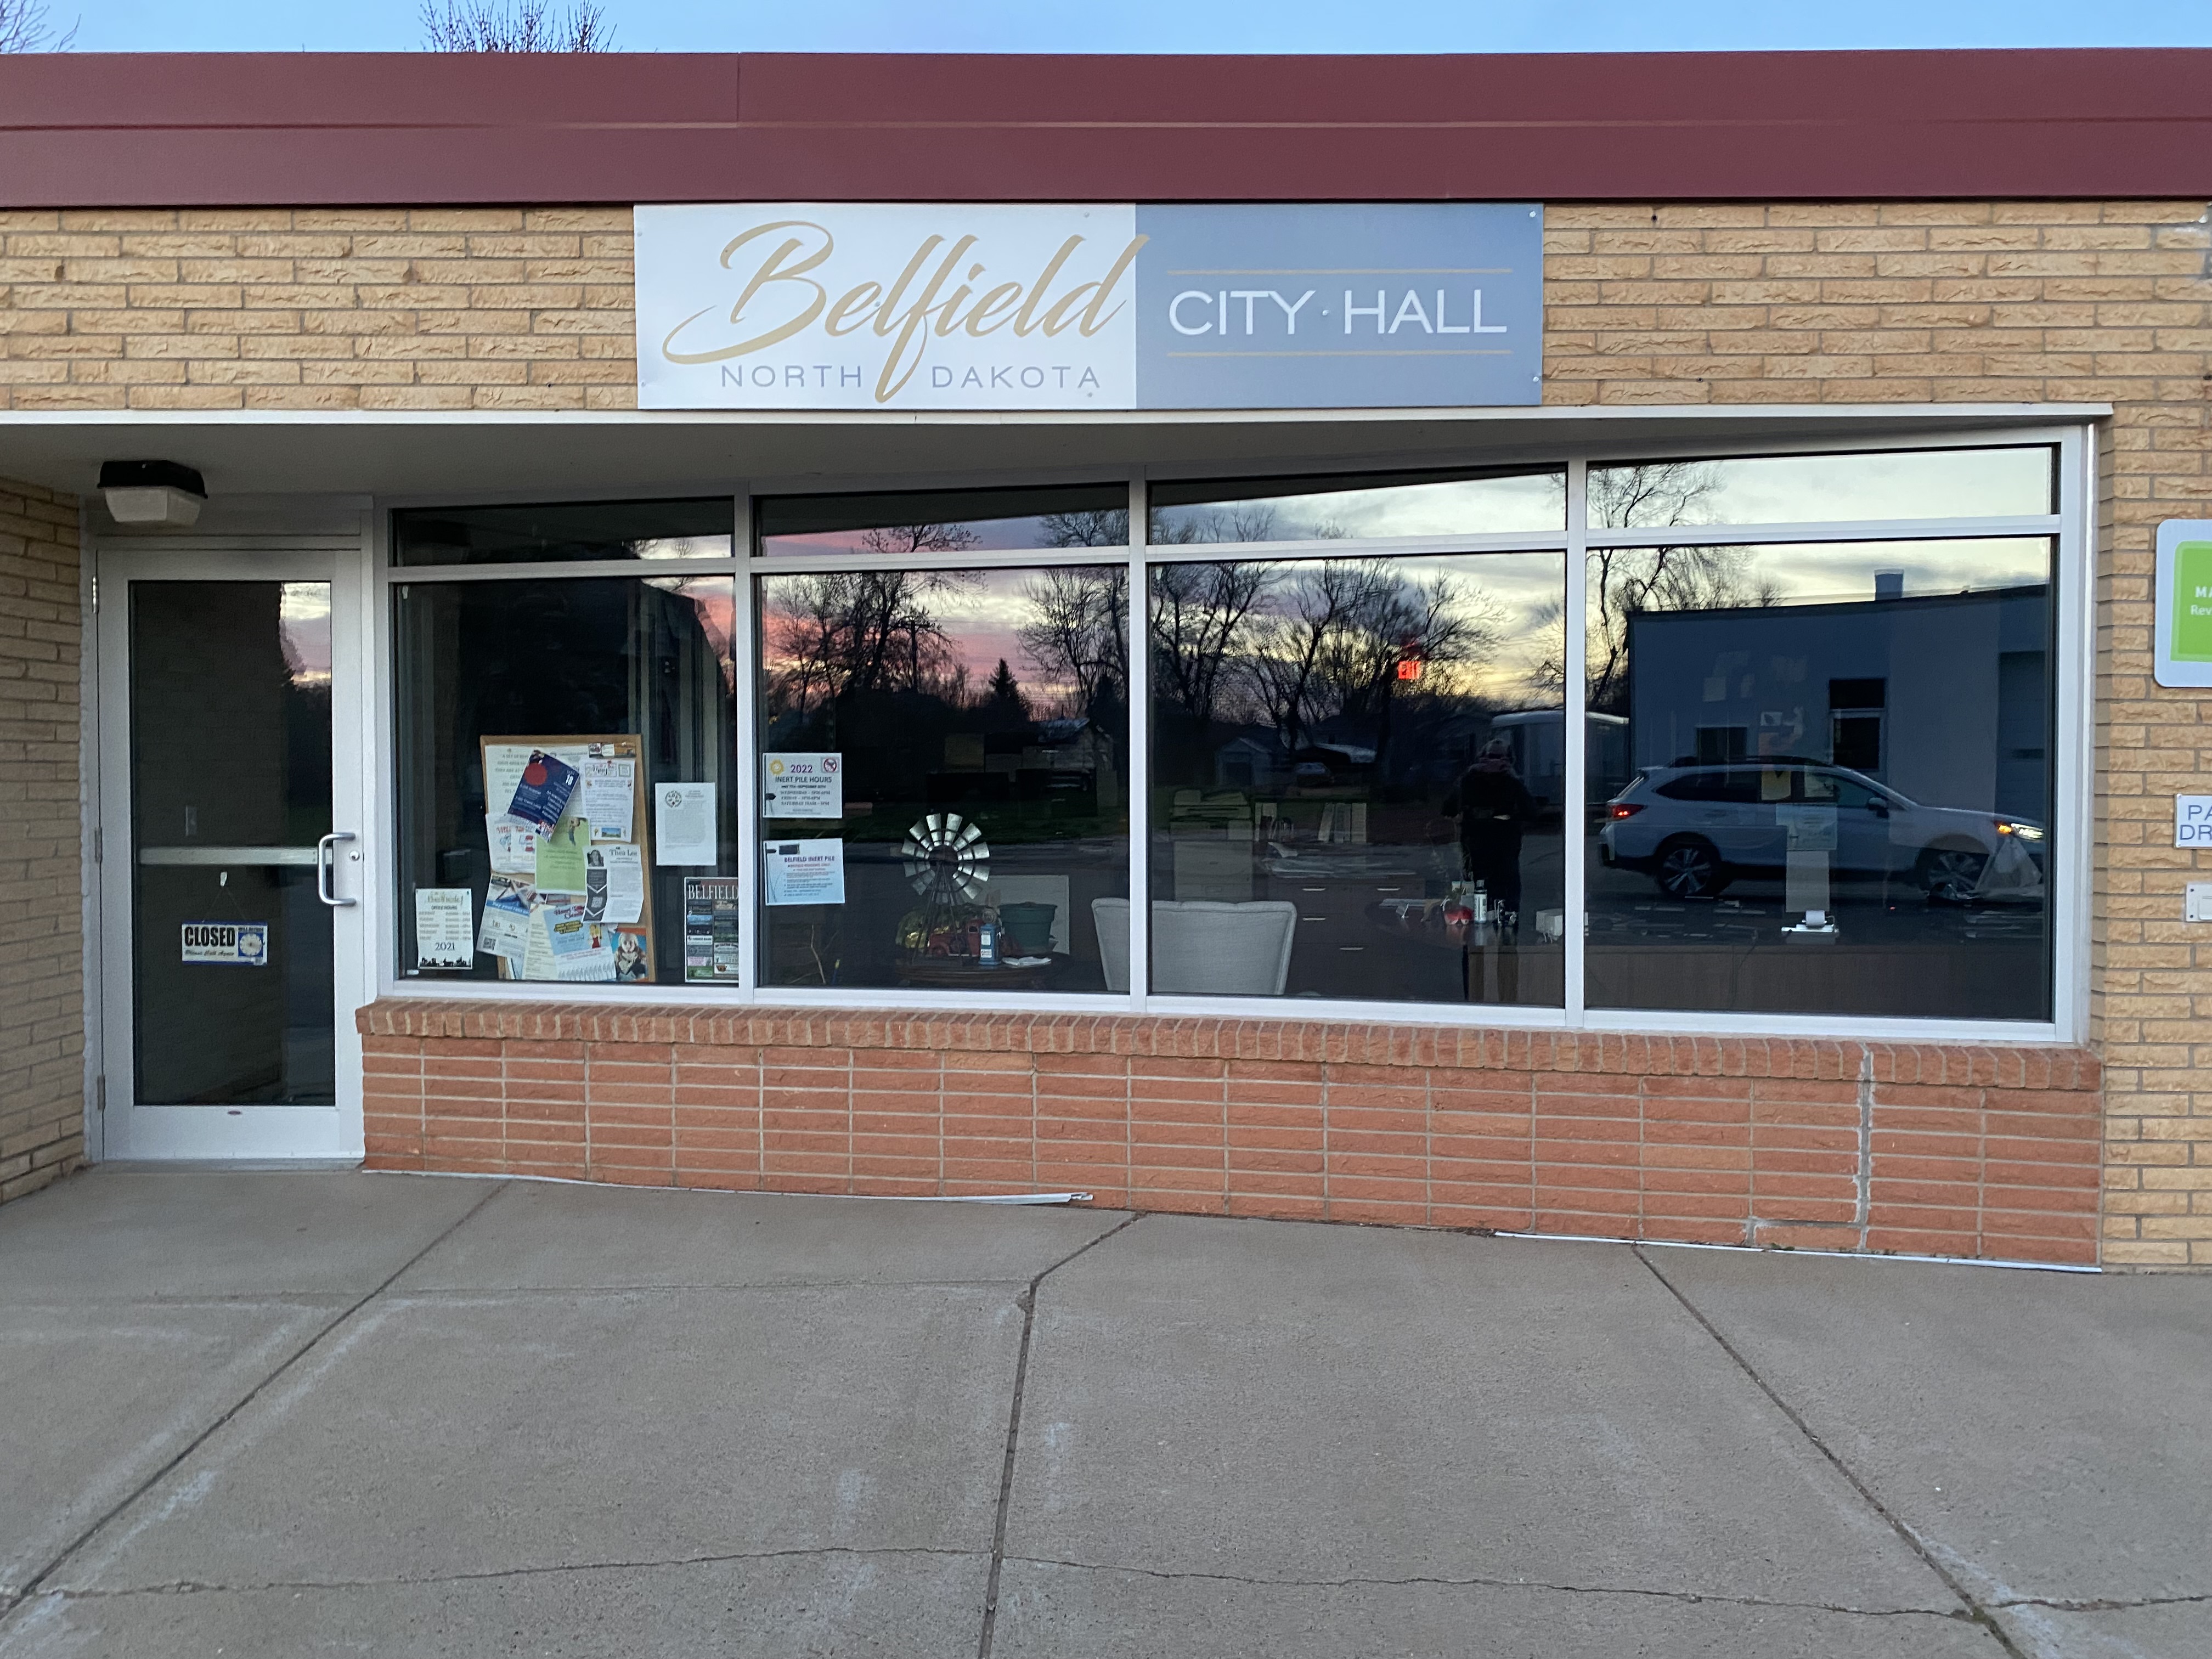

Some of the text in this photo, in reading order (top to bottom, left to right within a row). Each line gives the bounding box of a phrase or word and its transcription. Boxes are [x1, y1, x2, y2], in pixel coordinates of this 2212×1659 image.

[662, 221, 1150, 403] Belfield
[1169, 289, 1508, 335] CITY HALL
[721, 365, 1101, 389] NORTH DAKOTA
[1398, 661, 1421, 679] EXIT
[791, 764, 813, 773] 2022
[688, 884, 738, 900] BELFIELD
[184, 927, 235, 946] CLOSED
[435, 942, 455, 951] 2021
